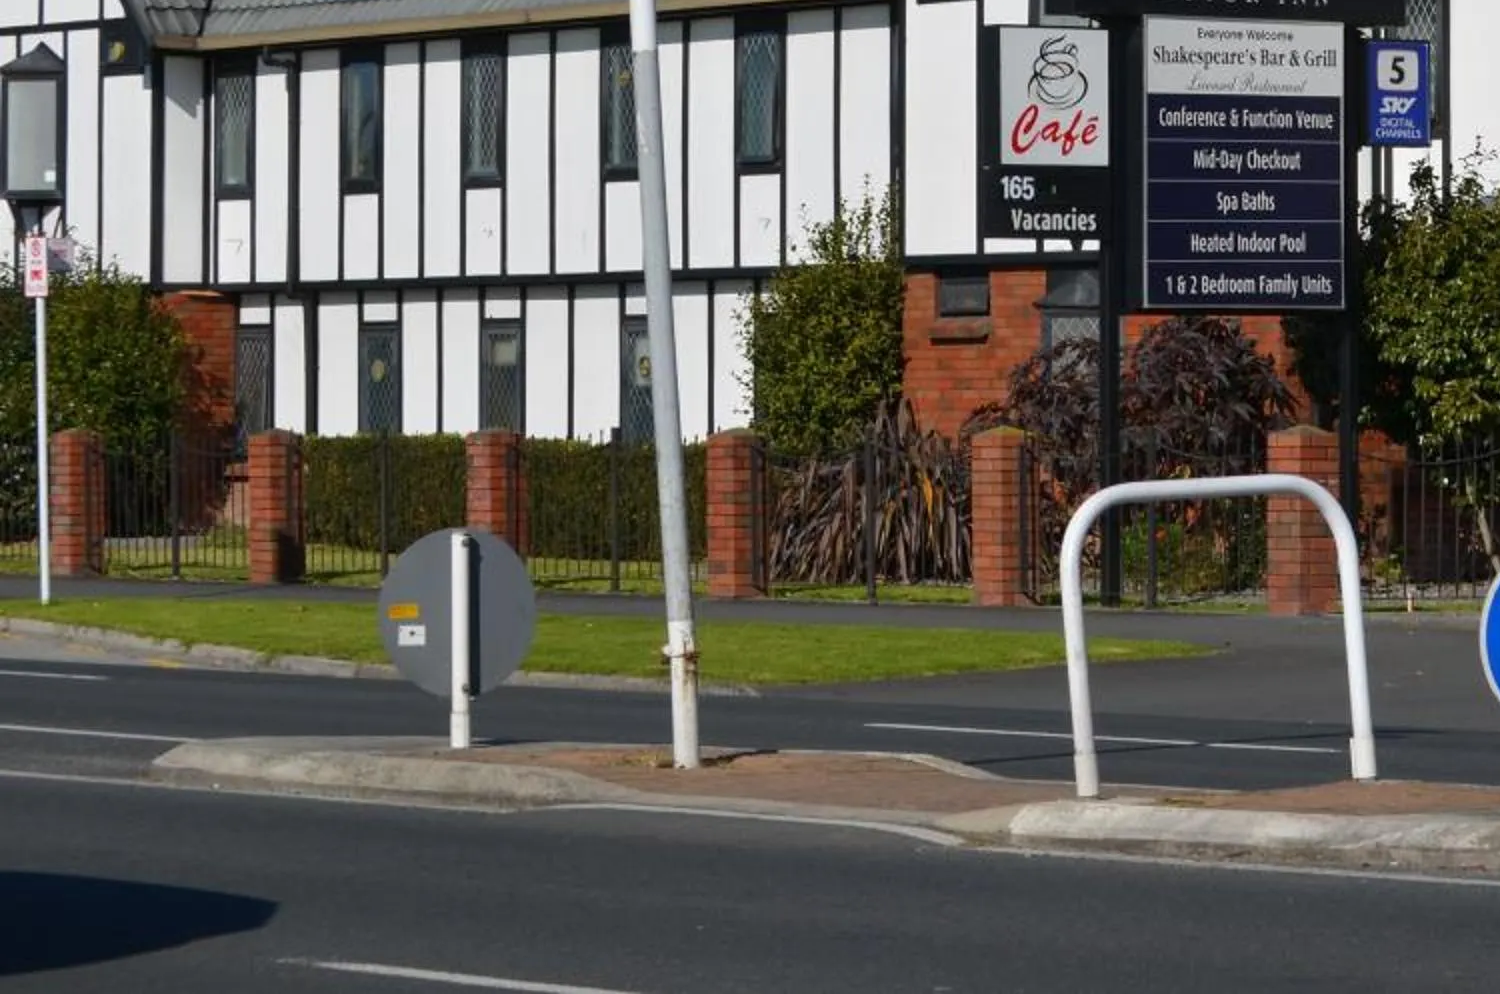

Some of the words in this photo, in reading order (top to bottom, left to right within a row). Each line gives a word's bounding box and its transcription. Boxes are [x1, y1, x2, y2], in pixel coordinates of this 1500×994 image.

[1197, 28, 1243, 41] Everyone
[1246, 29, 1294, 42] Welcome
[1152, 46, 1257, 70] Shakespeare's
[1260, 49, 1285, 67] Bar
[1289, 49, 1300, 67] &
[1304, 49, 1337, 67] Grill
[1389, 56, 1405, 84] 5
[1159, 106, 1227, 127] Conference
[1230, 108, 1239, 127] &
[1243, 108, 1293, 128] Function
[1295, 110, 1334, 129] Venue
[1011, 104, 1099, 156] Café
[1193, 148, 1243, 174] Mid-Day
[1247, 148, 1301, 170] Checkout
[1000, 175, 1035, 201] 165
[1216, 191, 1239, 214] Spa
[1241, 190, 1276, 211] Baths
[1010, 207, 1097, 231] Vacancies
[1191, 231, 1235, 253] Heated
[1237, 231, 1277, 253] Indoor
[1279, 231, 1307, 253] Pool
[1165, 275, 1173, 294] 1
[1177, 275, 1186, 294] &
[1189, 275, 1198, 294] 2
[1201, 273, 1255, 294] Bedroom
[1259, 273, 1299, 299] Family
[1301, 273, 1333, 294] Units
